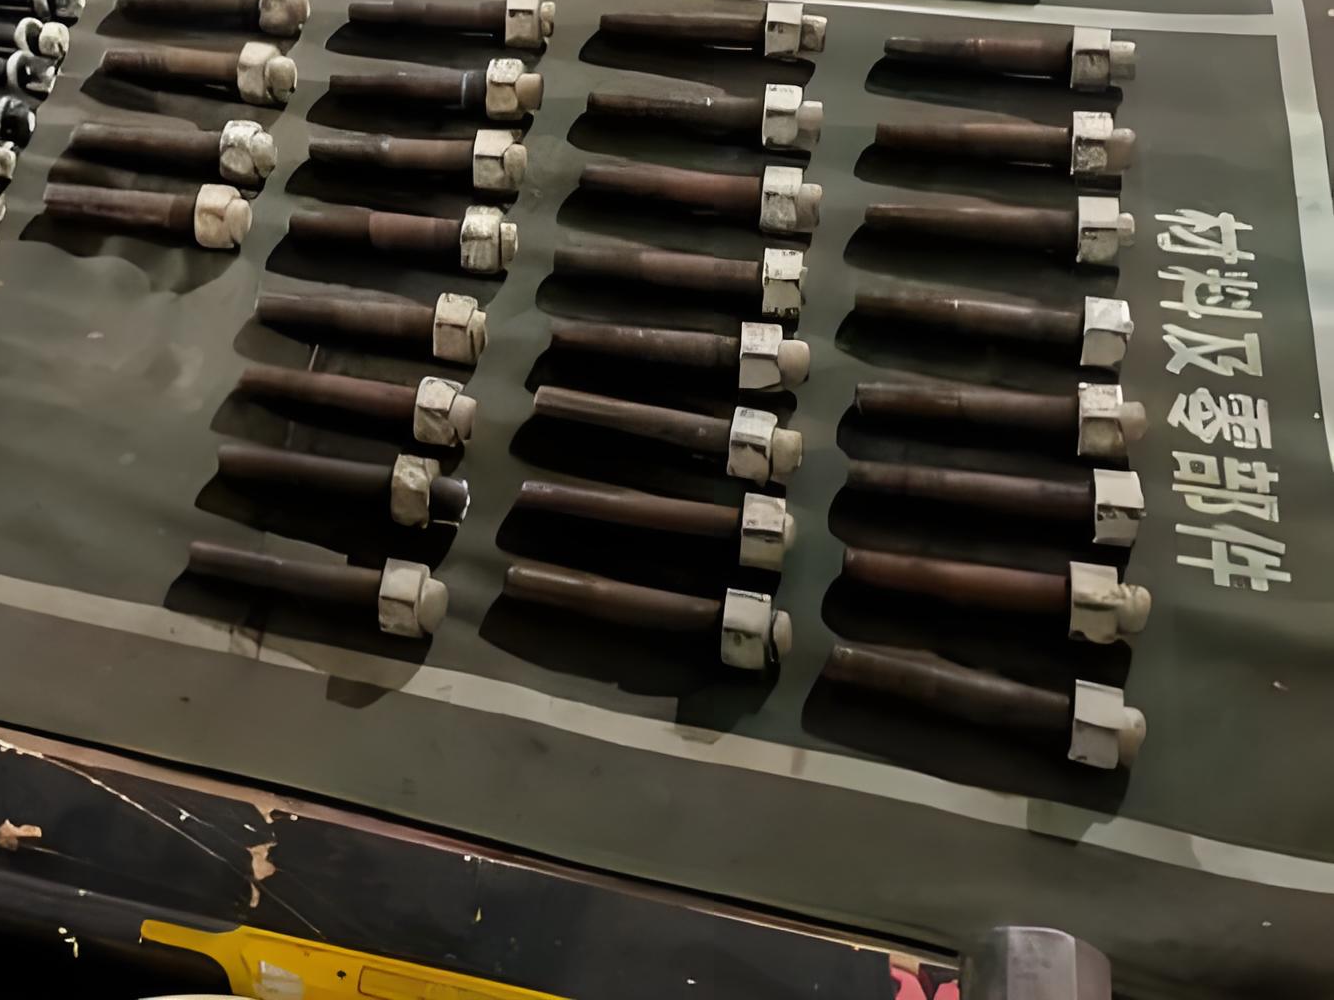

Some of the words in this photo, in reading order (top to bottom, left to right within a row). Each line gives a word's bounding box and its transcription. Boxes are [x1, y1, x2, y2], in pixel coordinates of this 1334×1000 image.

[1154, 208, 1292, 592] 材料及零部件
